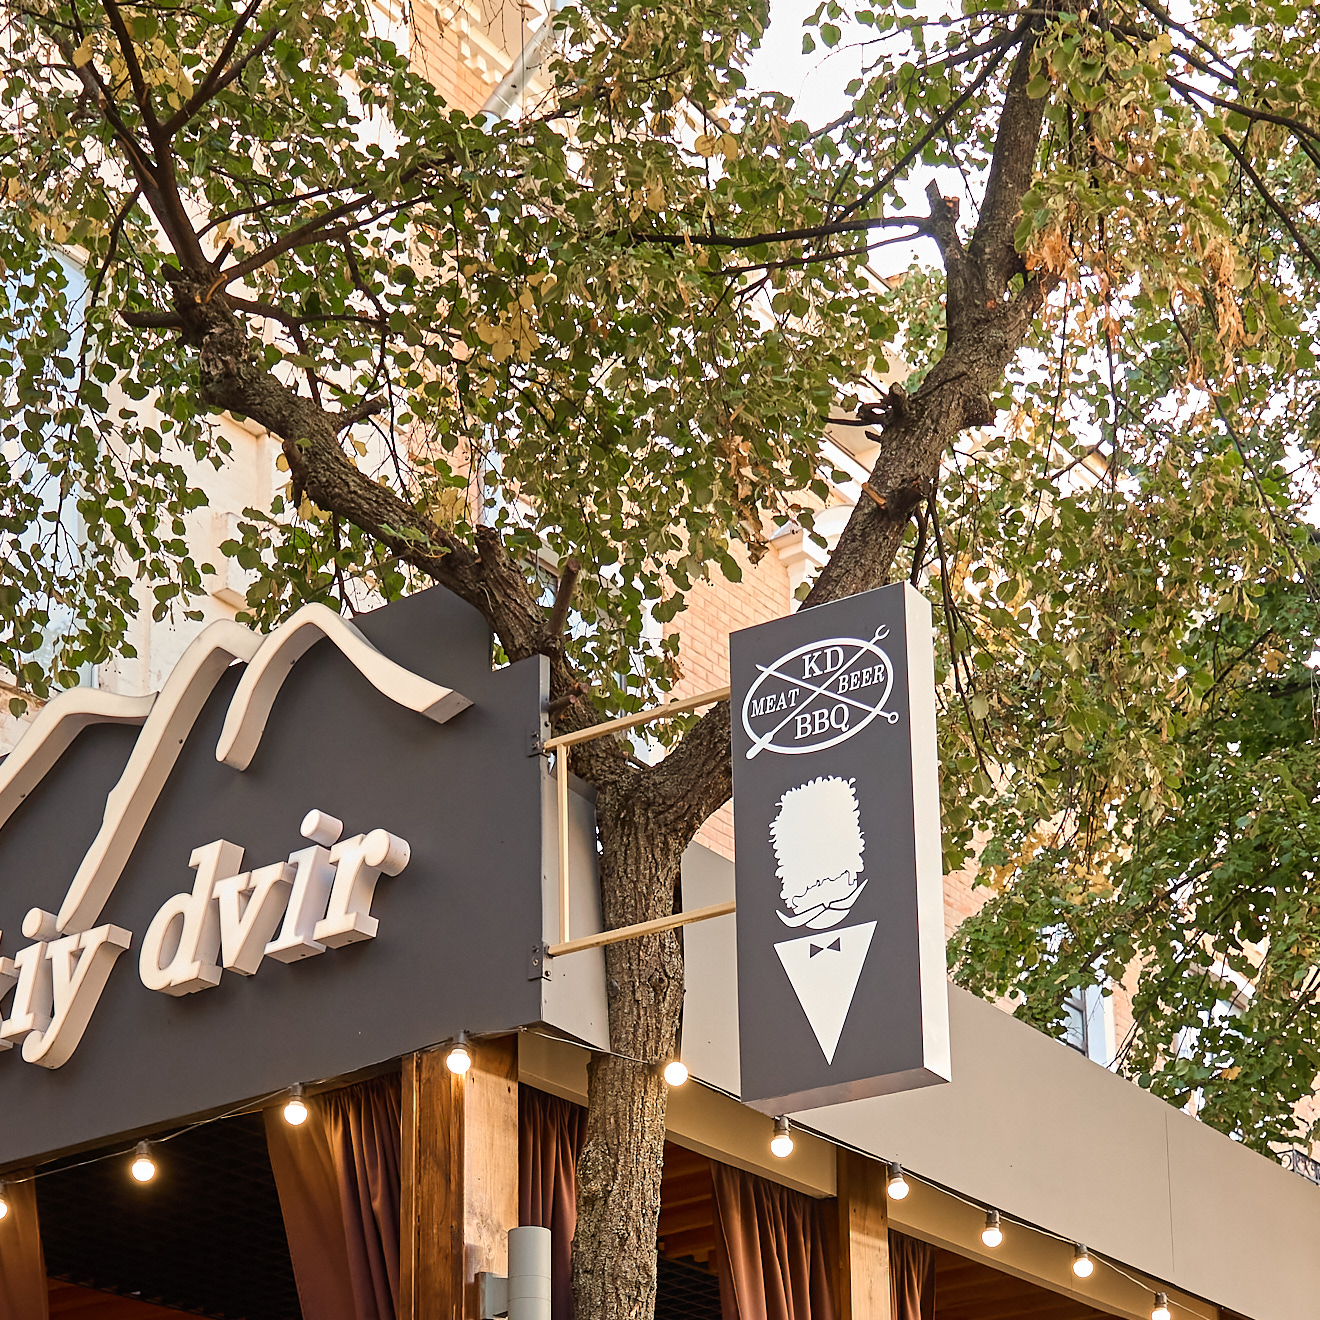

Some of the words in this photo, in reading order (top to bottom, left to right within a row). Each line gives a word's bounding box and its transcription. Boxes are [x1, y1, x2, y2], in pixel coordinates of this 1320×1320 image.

[801, 646, 844, 680] KD
[837, 664, 885, 694] BEER
[750, 688, 800, 717] MEAT
[794, 703, 850, 740] BBQ
[138, 808, 411, 997] dvir
